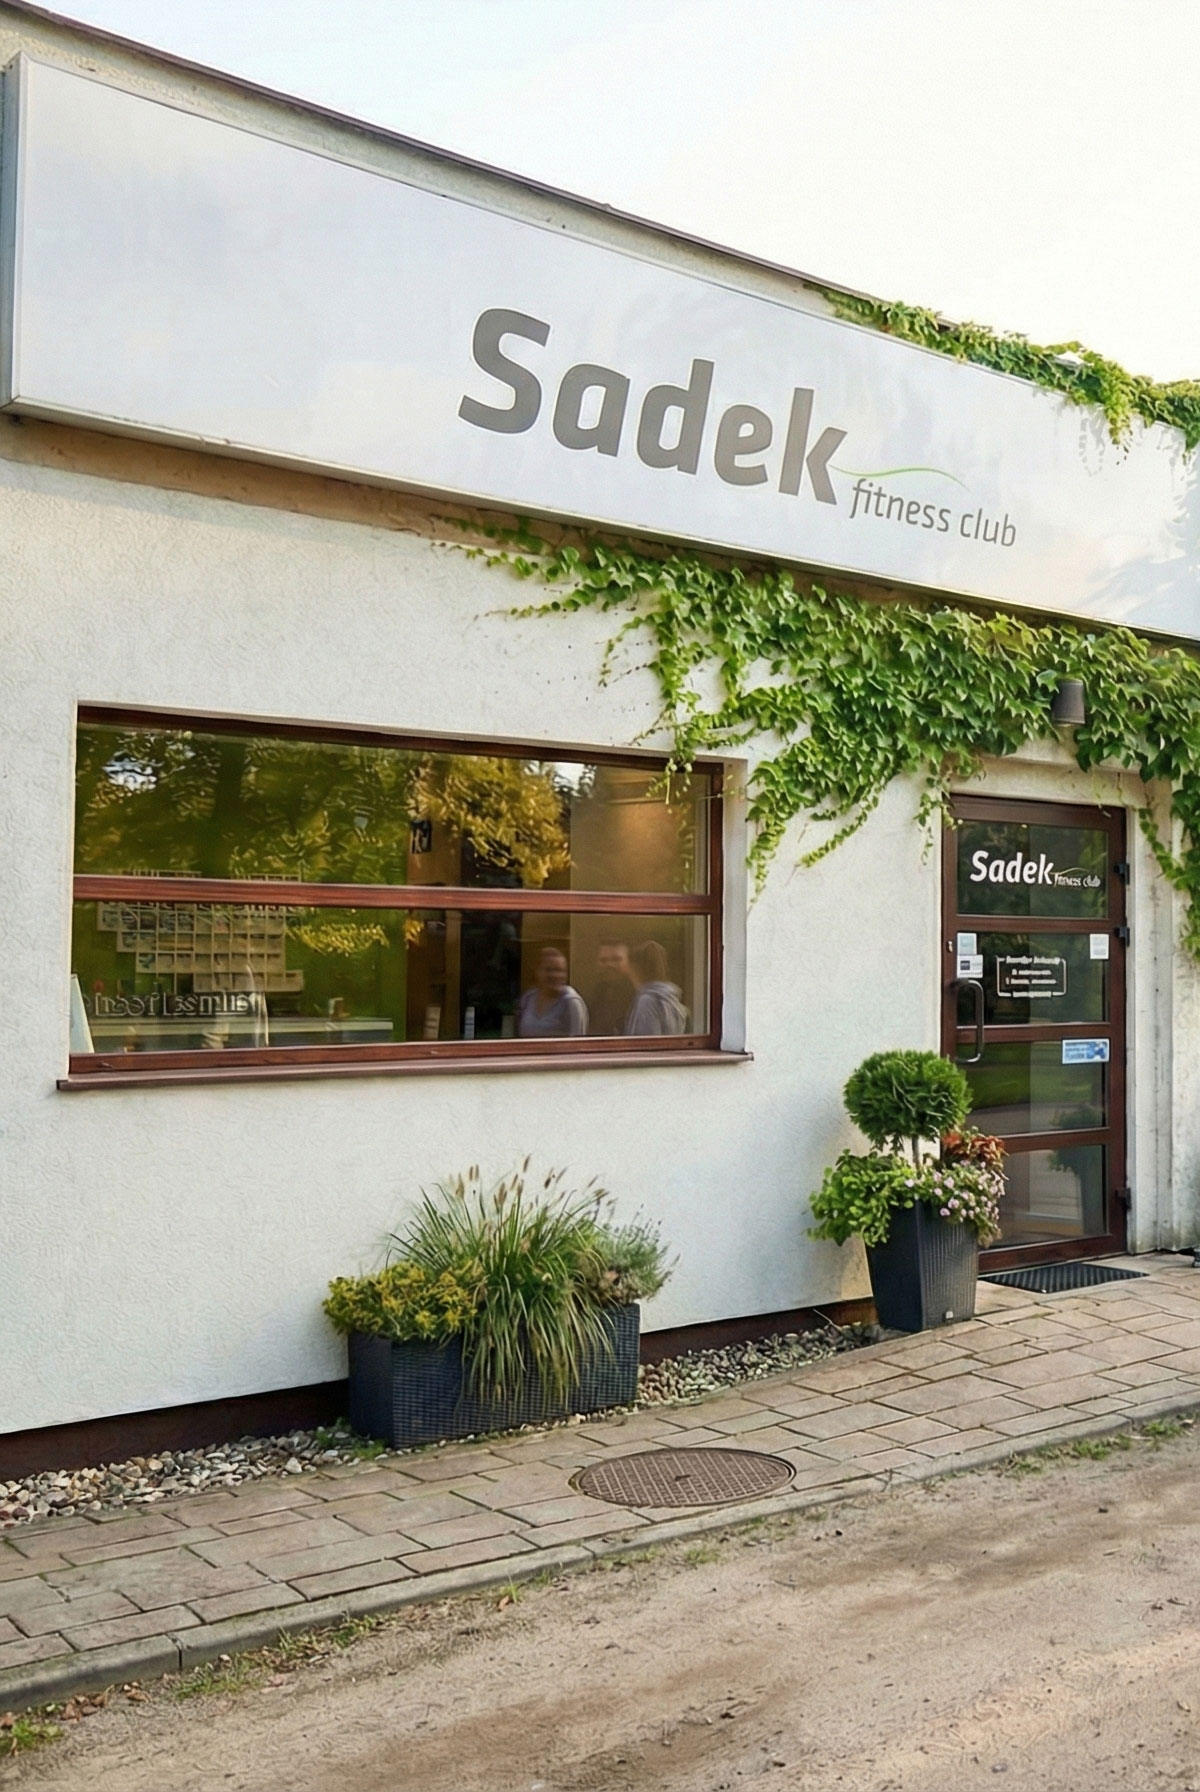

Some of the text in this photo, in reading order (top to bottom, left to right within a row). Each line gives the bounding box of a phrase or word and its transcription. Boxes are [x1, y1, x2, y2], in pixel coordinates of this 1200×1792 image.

[458, 307, 847, 505] Sadek
[849, 478, 1016, 547] fitness club
[969, 850, 1054, 885] Sadek
